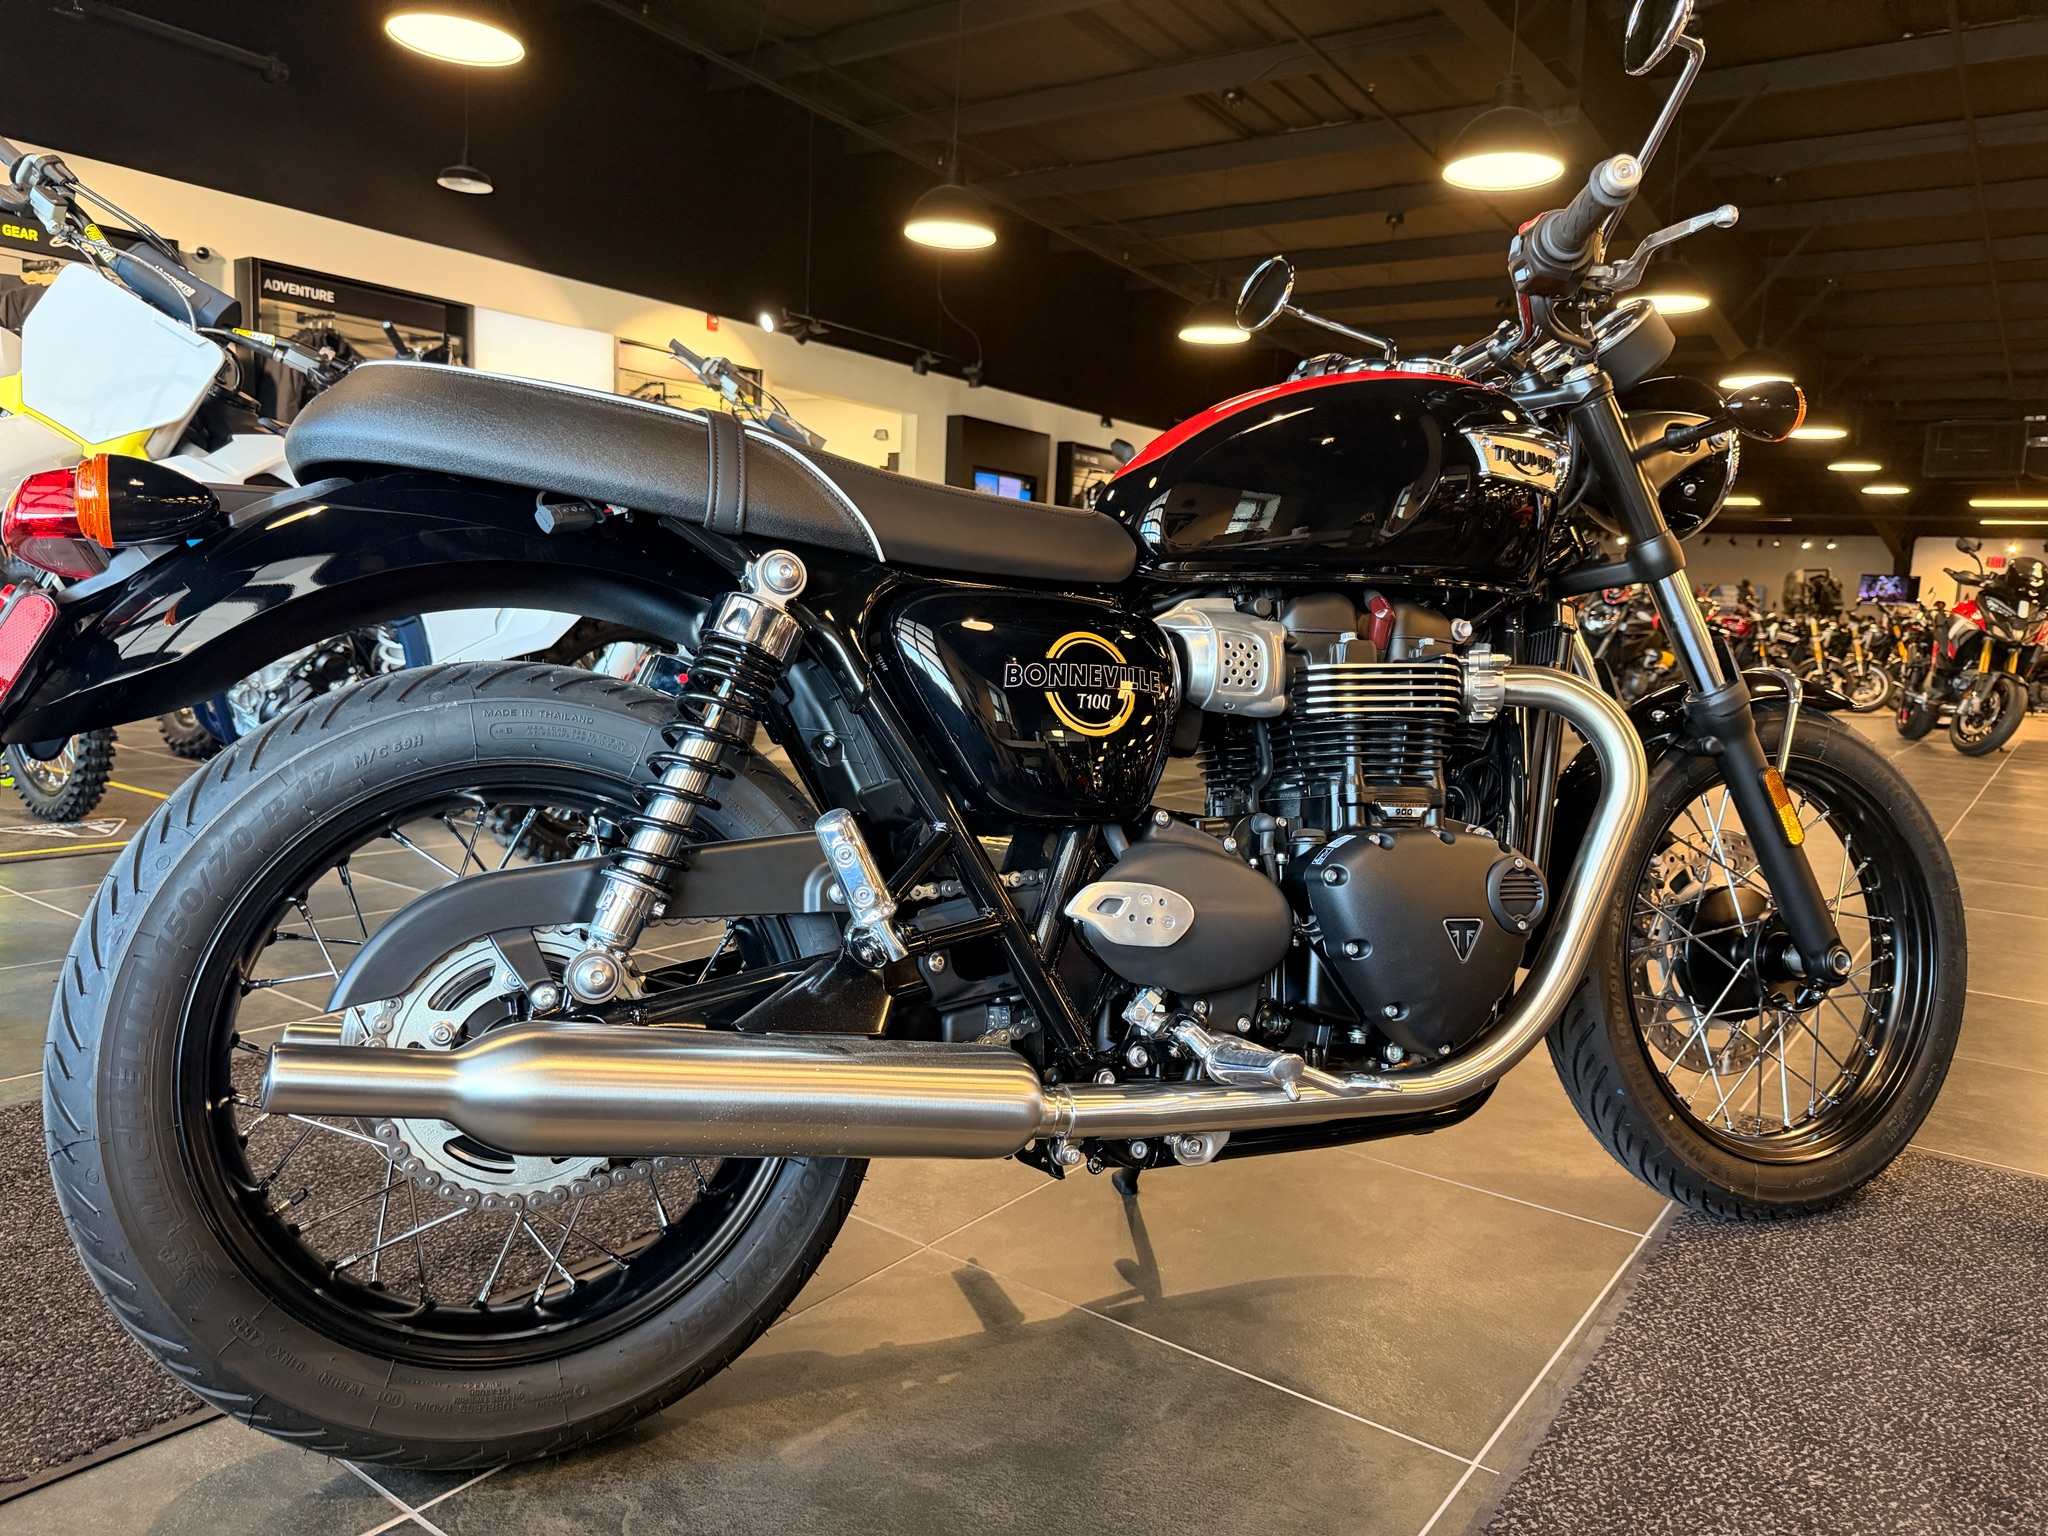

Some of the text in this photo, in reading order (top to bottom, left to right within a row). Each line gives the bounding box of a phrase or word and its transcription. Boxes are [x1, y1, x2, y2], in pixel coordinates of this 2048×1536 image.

[2, 224, 38, 242] GEAR
[263, 278, 336, 303] ADVENTURE
[1003, 662, 1161, 694] BONNEVILLE
[1077, 693, 1111, 710] T100
[483, 708, 594, 725] MADE IN THAILAND
[295, 760, 338, 803] 17
[352, 743, 389, 770] M/C
[392, 734, 425, 753] 69H
[1395, 808, 1413, 816] 900
[118, 978, 175, 1226] MICHELIN
[376, 1391, 400, 1405] DOT
[413, 1400, 517, 1414] TUBELESS RADIAL
